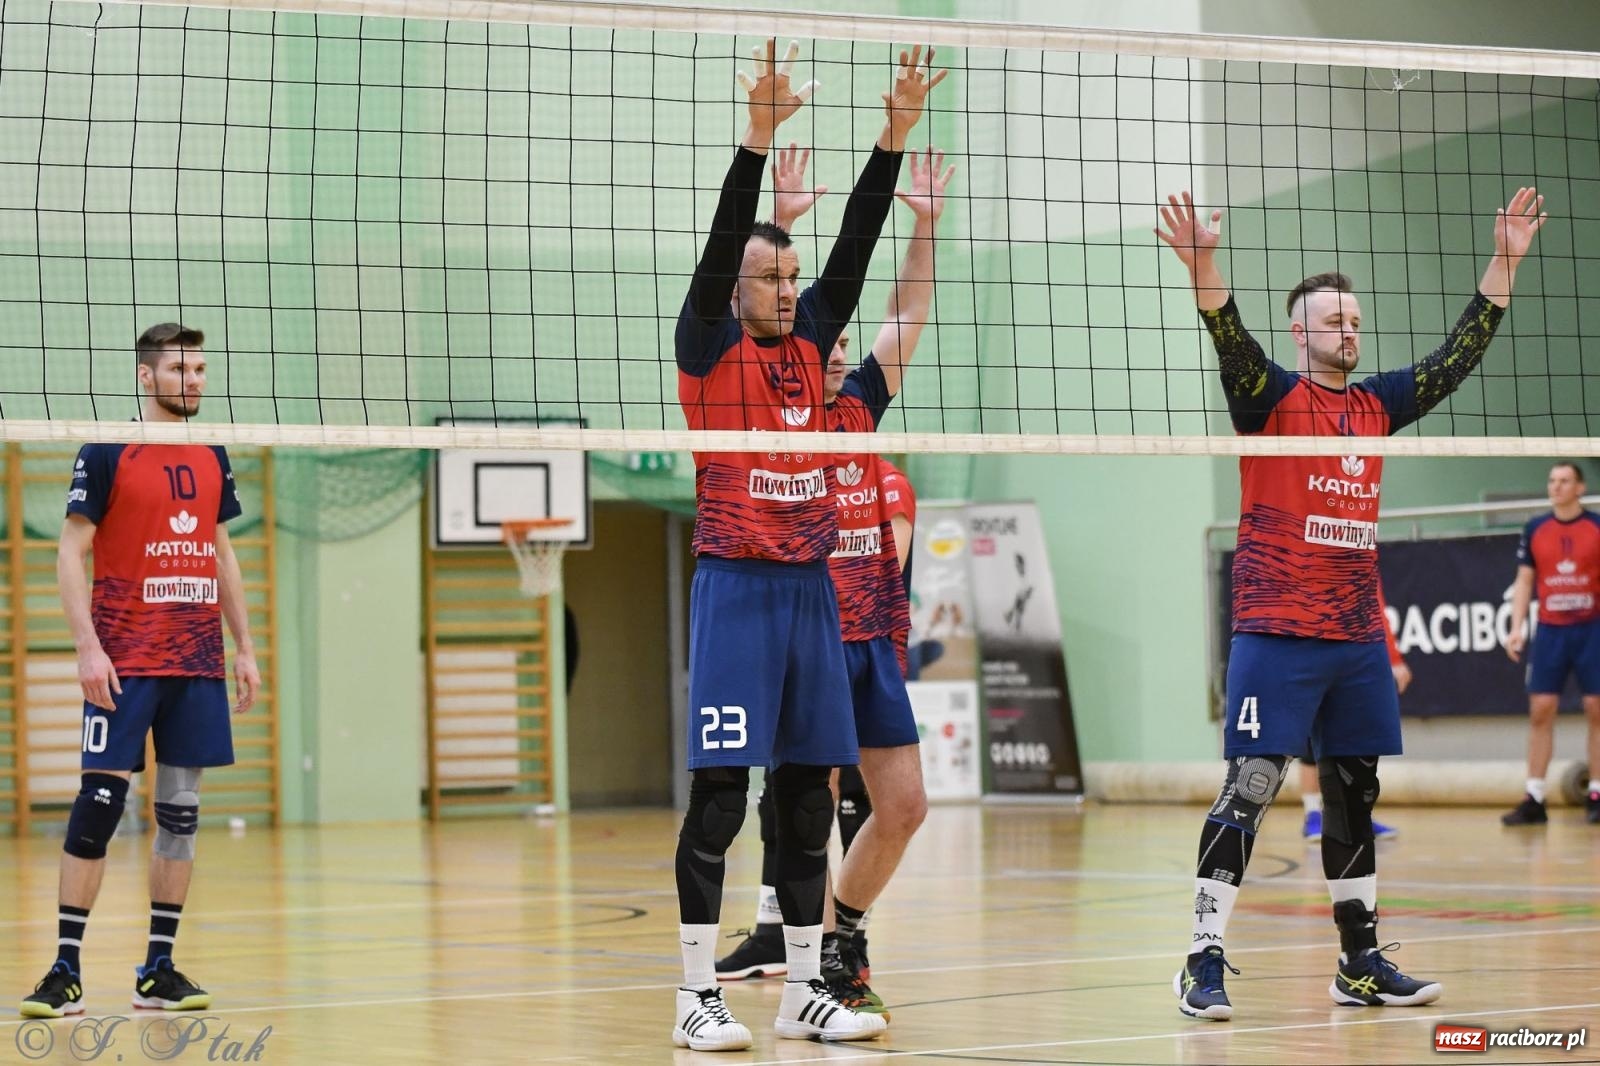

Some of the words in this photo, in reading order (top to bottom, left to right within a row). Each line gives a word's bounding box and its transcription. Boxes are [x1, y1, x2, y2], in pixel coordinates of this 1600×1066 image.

[163, 464, 197, 500] 10
[1308, 474, 1380, 499] KATOLIK
[1326, 498, 1373, 511] GROUP
[145, 540, 217, 558] KATOLIK
[160, 560, 207, 569] GROUP
[146, 577, 215, 603] nowiny.pl
[700, 705, 748, 750] 23
[1237, 696, 1261, 739] 4
[82, 715, 109, 753] 10
